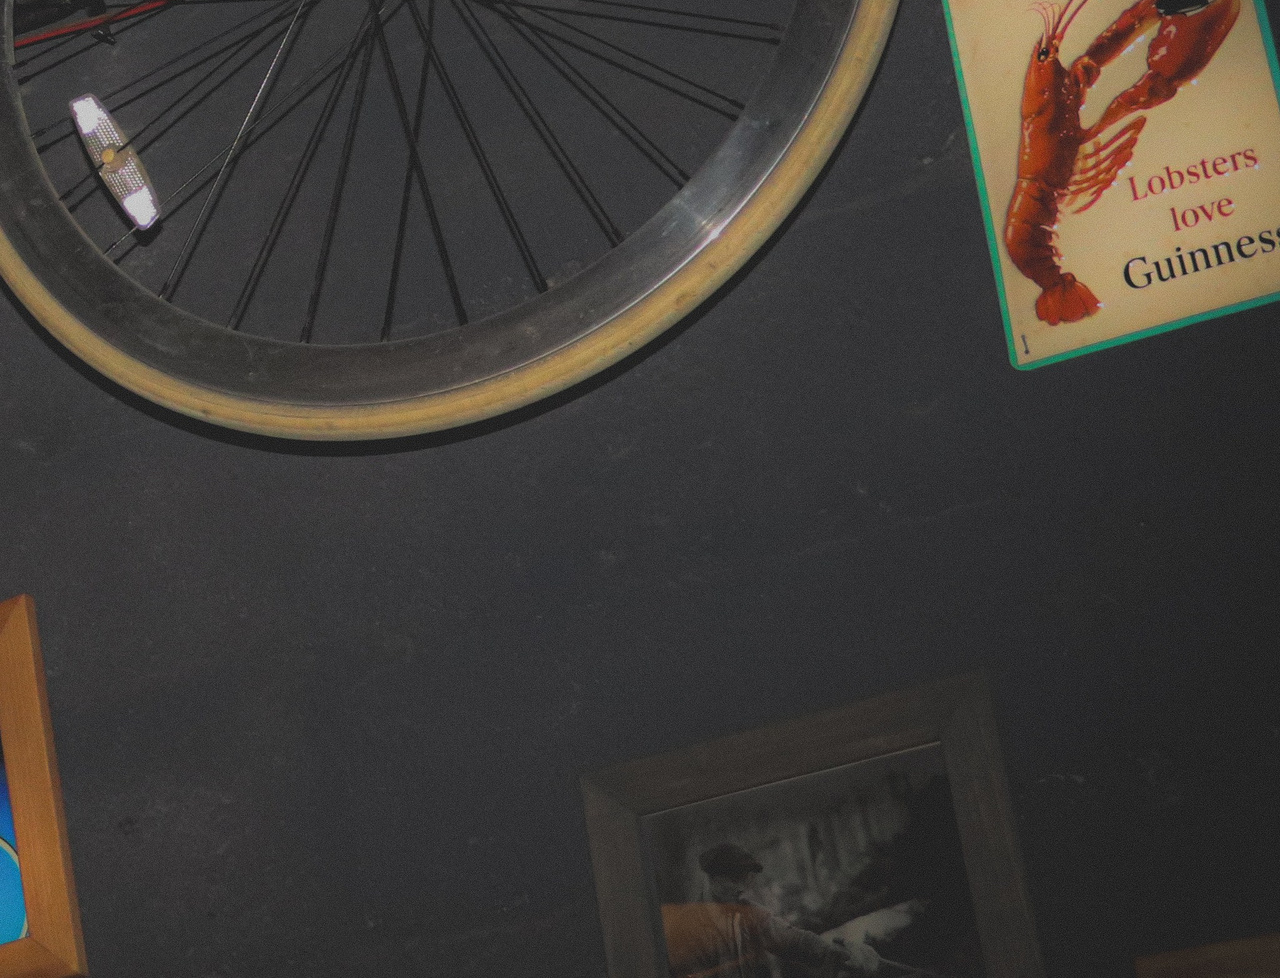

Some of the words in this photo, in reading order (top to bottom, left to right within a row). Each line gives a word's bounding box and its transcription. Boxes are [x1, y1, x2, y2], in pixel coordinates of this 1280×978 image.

[1128, 148, 1259, 201] Lobsters
[1169, 197, 1236, 232] love
[1123, 227, 1280, 289] Guinnes
